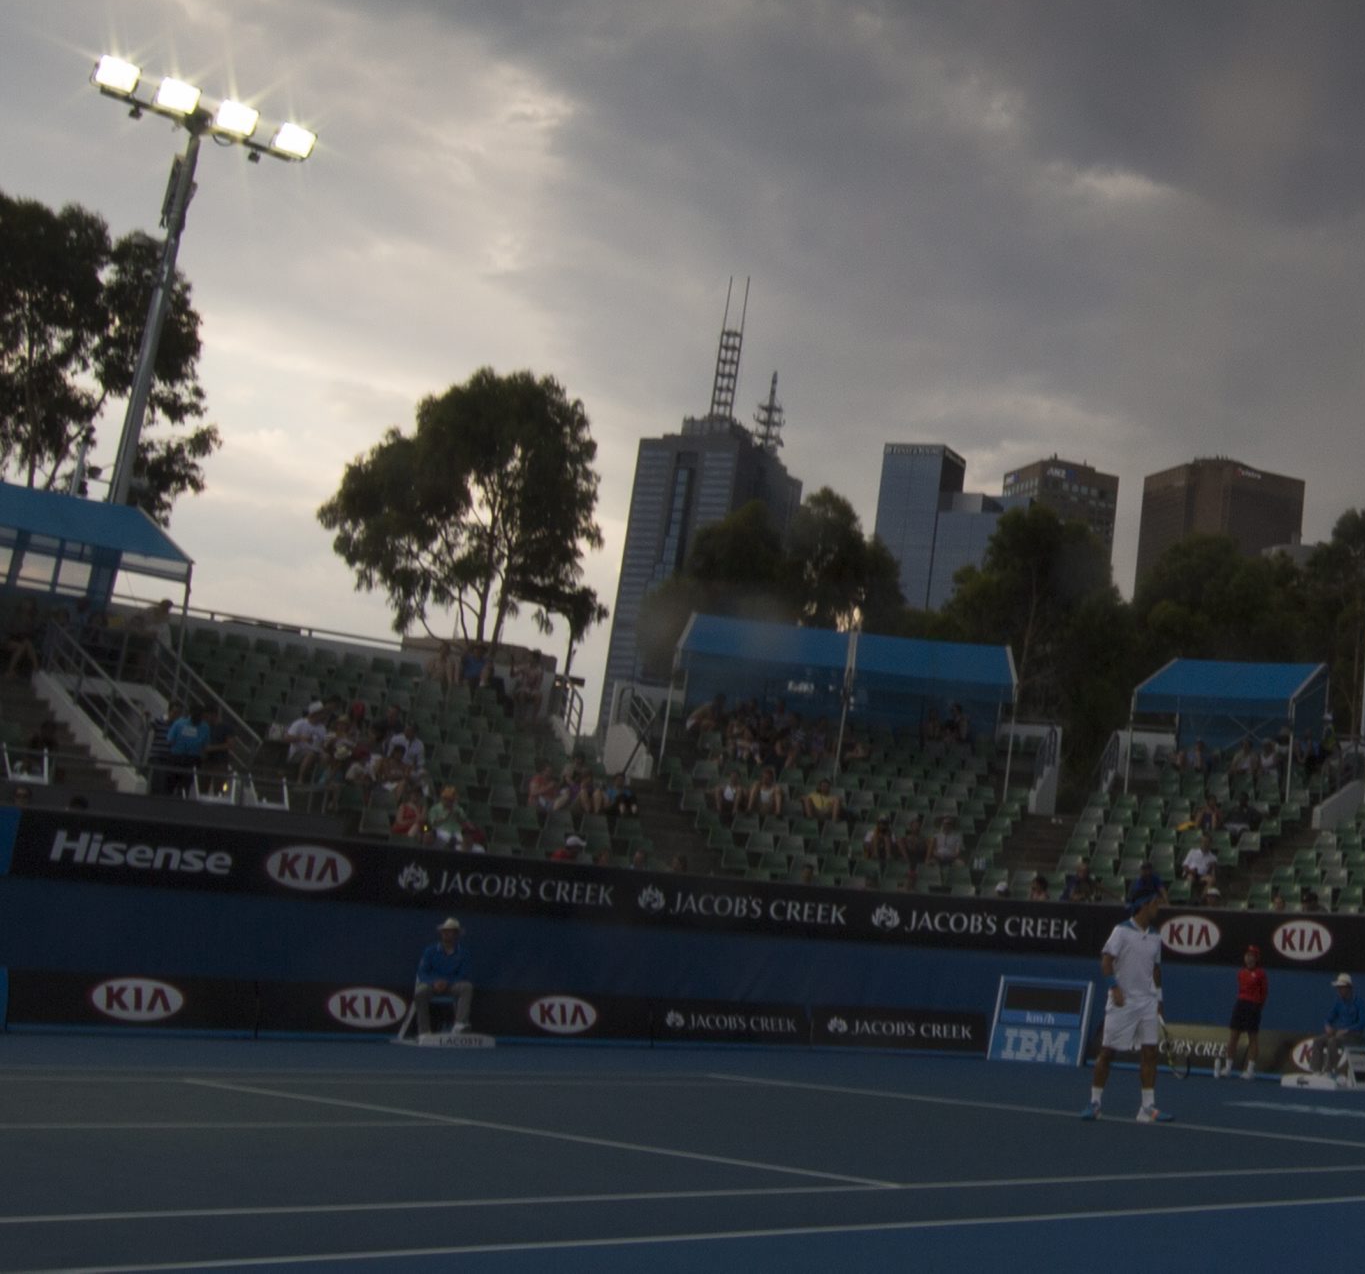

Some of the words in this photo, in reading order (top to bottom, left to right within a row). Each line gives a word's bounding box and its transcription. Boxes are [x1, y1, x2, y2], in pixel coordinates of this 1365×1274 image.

[50, 829, 233, 876] Hisense
[277, 852, 340, 884] KIA
[433, 869, 532, 900] JACOB'S
[538, 878, 615, 907] CREEK
[669, 891, 763, 919] JACOB'S
[769, 899, 848, 926] CREEK
[904, 909, 997, 936] JACOB'S
[1004, 916, 1078, 941] CREEK
[1168, 923, 1212, 948] KIA
[1282, 928, 1324, 953] KIA
[106, 986, 172, 1014] KIA
[340, 994, 397, 1021] KIA
[539, 1002, 588, 1027] KIA
[687, 1012, 747, 1031] JACOB'S
[750, 1014, 798, 1033] CREEK
[1025, 1010, 1056, 1025] km/h
[850, 1019, 916, 1037] JACOB'S
[919, 1022, 973, 1041] CREEK
[1001, 1026, 1071, 1064] IBM
[1194, 1039, 1229, 1058] CREE
